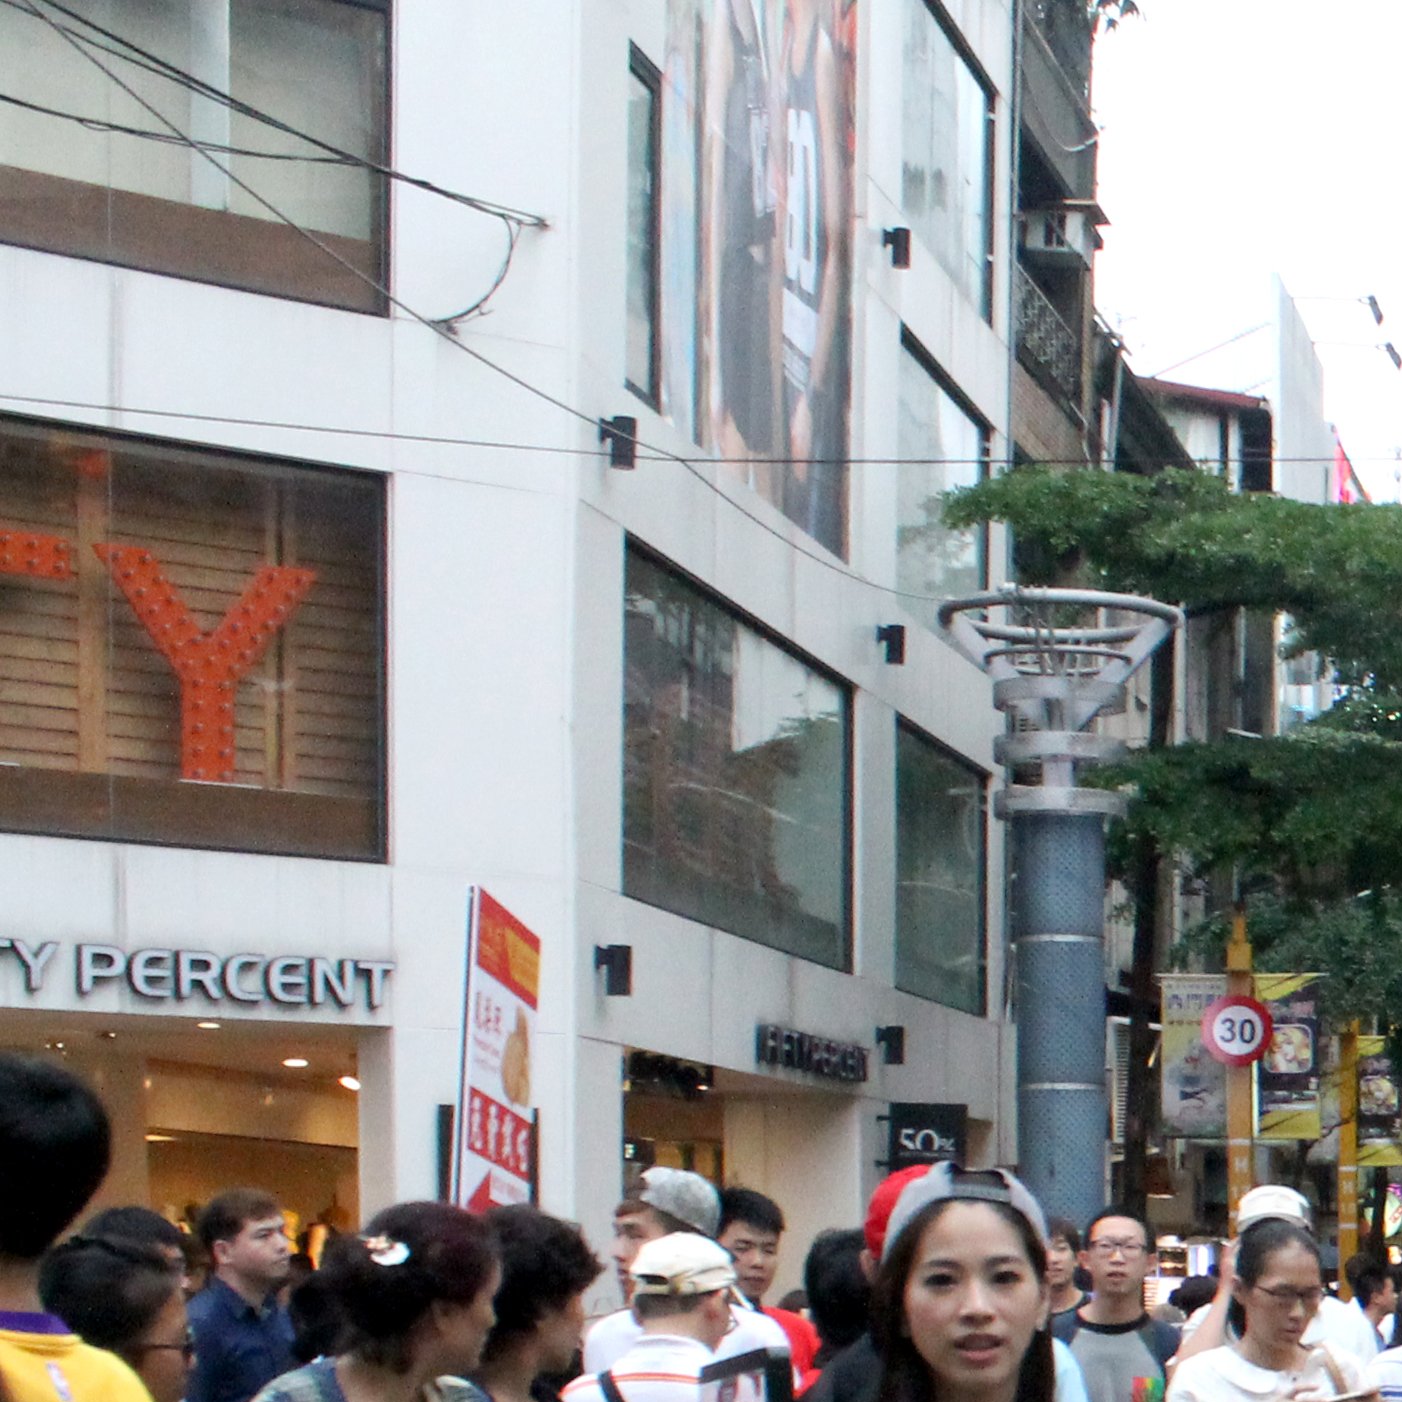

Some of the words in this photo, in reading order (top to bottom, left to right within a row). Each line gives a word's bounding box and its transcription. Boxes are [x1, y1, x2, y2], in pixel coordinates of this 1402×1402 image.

[0, 938, 60, 991] Y
[76, 943, 397, 1009] PERCENT
[1220, 1017, 1256, 1044] 30
